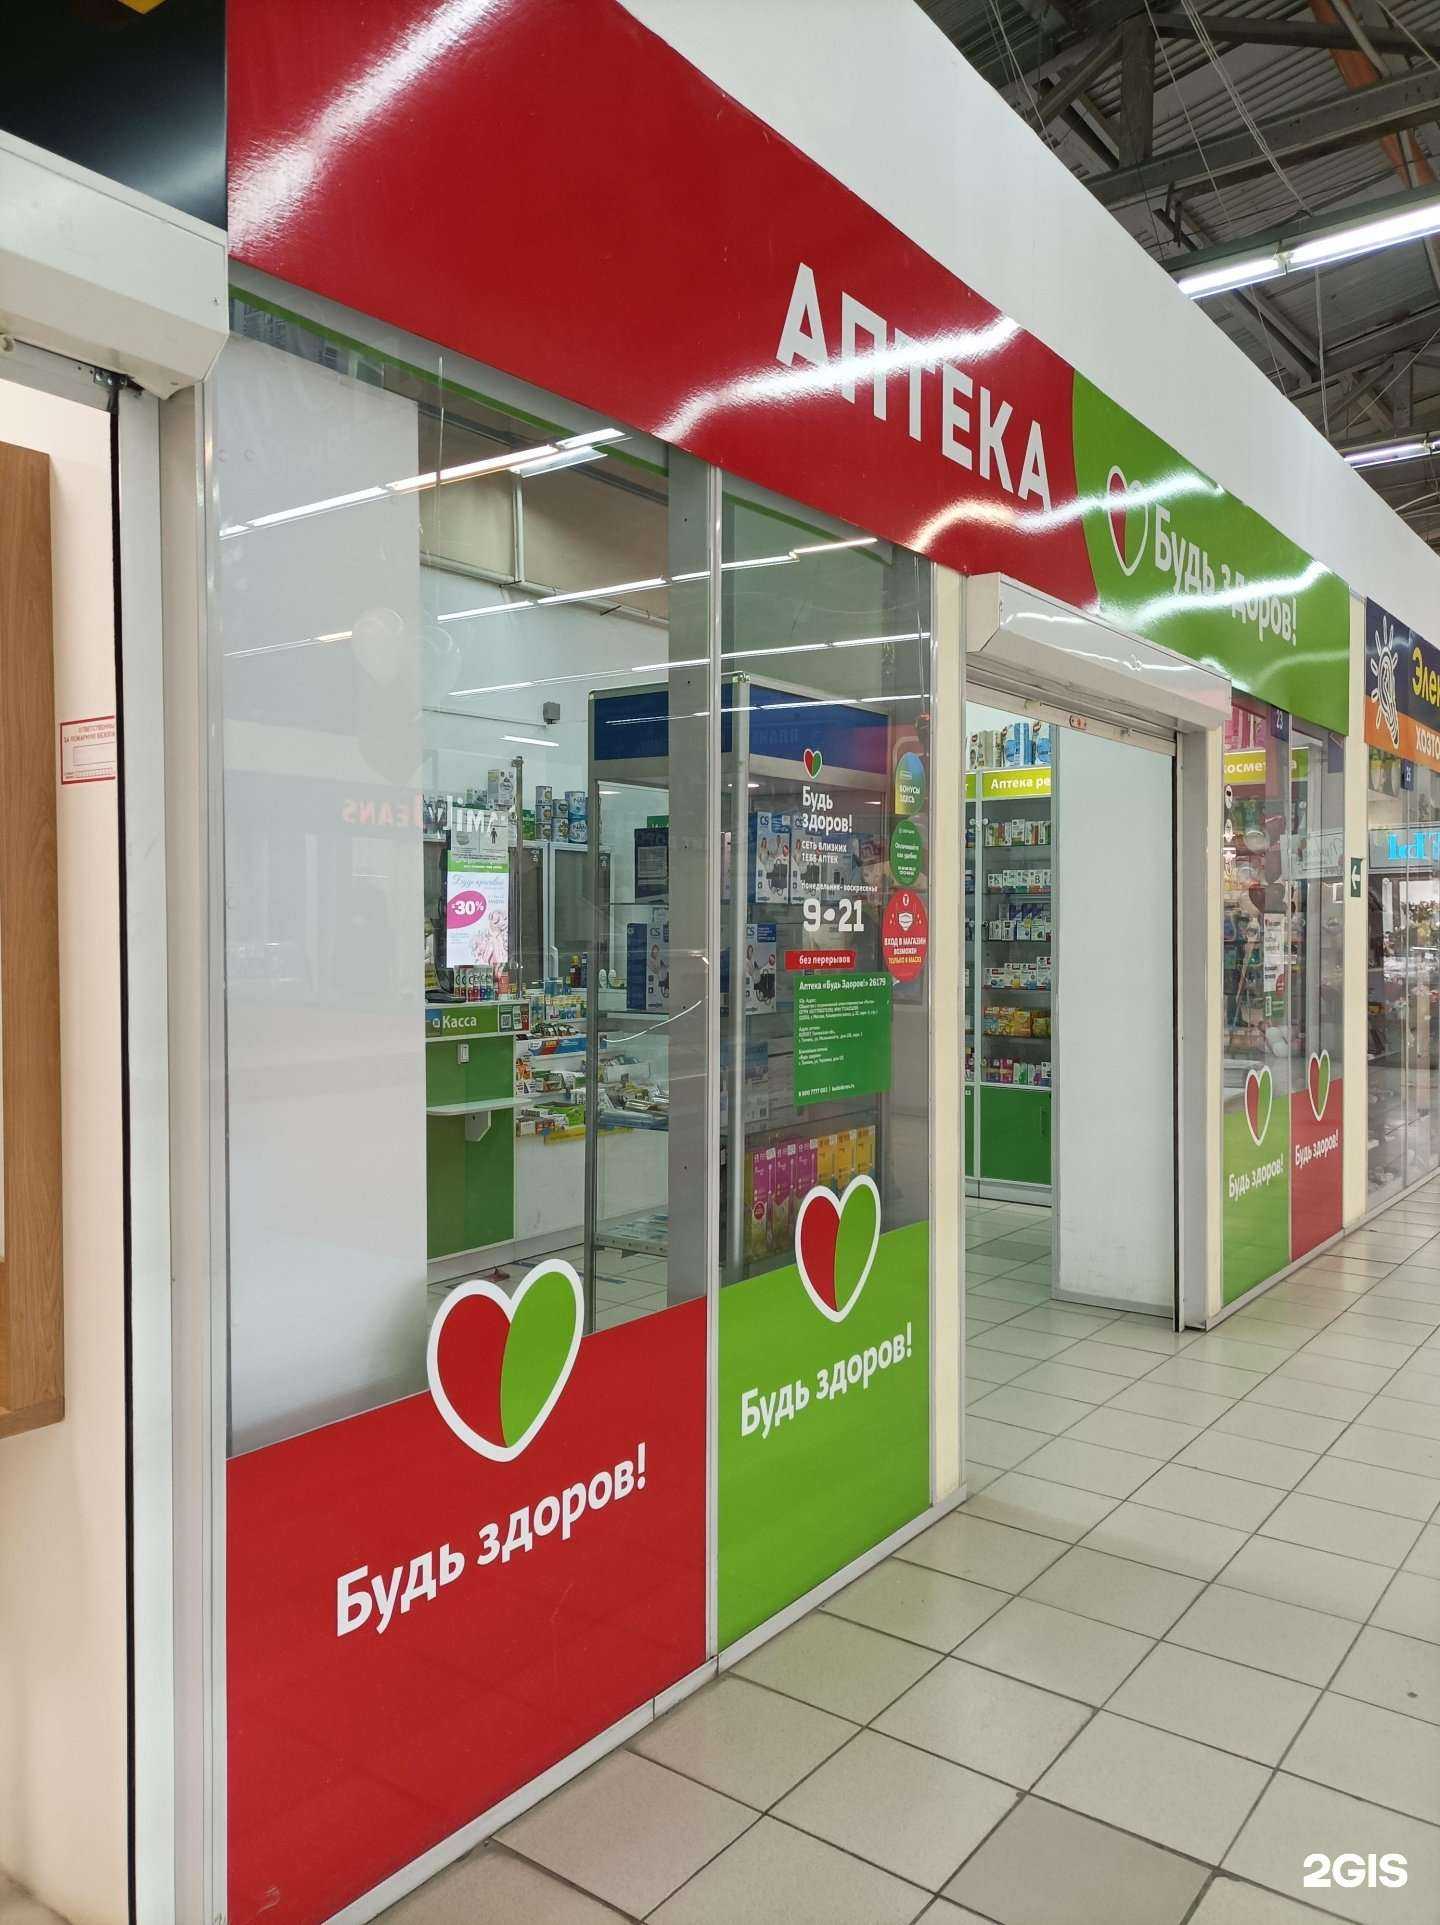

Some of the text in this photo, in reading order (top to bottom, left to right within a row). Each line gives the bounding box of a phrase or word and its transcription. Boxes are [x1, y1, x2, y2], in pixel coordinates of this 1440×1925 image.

[776, 262, 1052, 513] АПТЕКА
[1155, 503, 1297, 646] Будь здоров!
[991, 778, 1033, 790] Аптека
[802, 785, 833, 811] Будь
[802, 814, 852, 837] здоров!
[801, 840, 847, 853] СЕТЬ БЛИЗКИХ
[801, 853, 839, 865] ТЕБЕ АПТЕК
[451, 900, 484, 915] -30%
[884, 937, 898, 947] ВХОД
[903, 937, 927, 946] МАГАЗИН
[798, 955, 852, 967] без перерывов
[799, 980, 822, 991] Аптека
[442, 1015, 477, 1029] Касса
[1295, 1129, 1339, 1169] Будь здоров!
[1229, 1153, 1284, 1201] Будь здоров!
[741, 1321, 912, 1439] Будь здоров!
[337, 1441, 646, 1637] Будь здоров!
